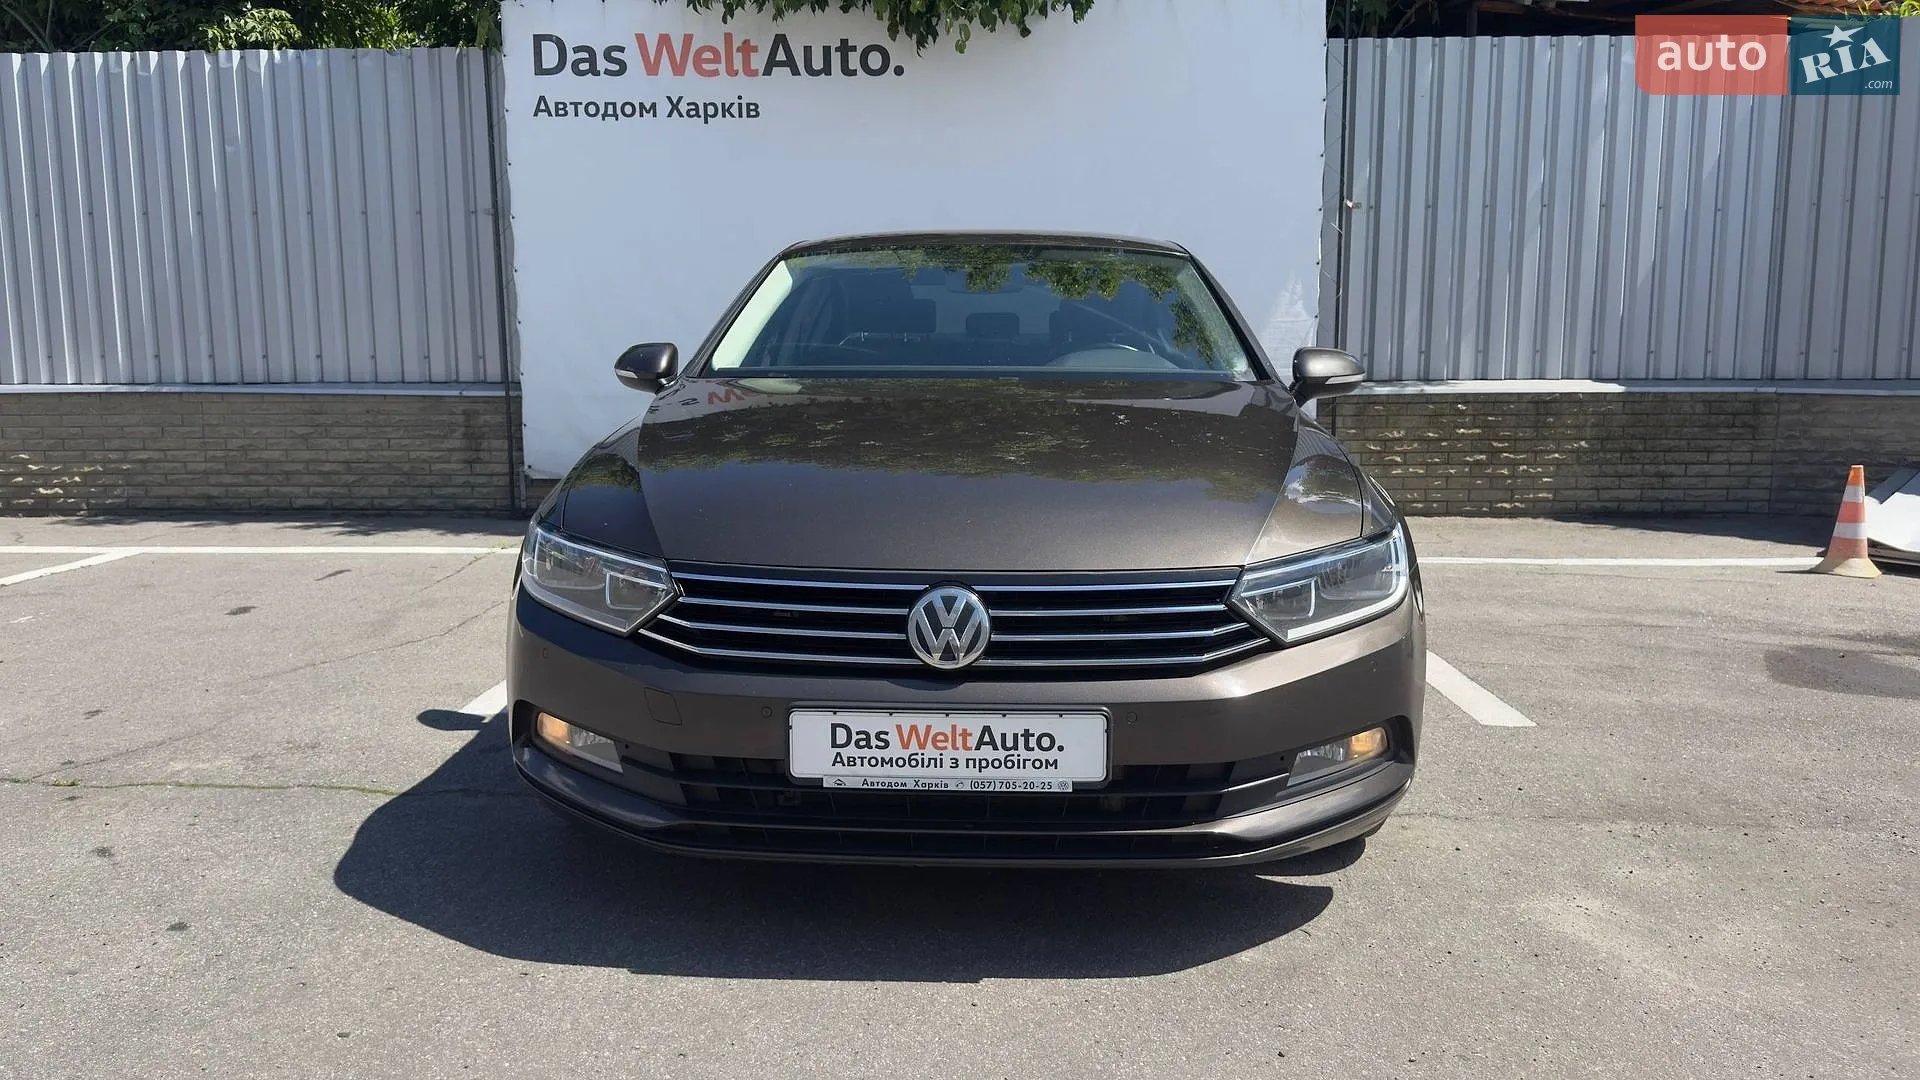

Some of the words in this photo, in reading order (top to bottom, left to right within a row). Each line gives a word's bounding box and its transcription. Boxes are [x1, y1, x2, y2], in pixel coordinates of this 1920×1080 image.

[532, 33, 627, 77] Das
[532, 95, 657, 120] Автодом
[666, 95, 760, 124] Харків
[830, 722, 890, 749] Das
[831, 752, 944, 769] Автомобілі
[949, 755, 959, 769] з
[965, 754, 1059, 773] пробігом
[862, 778, 907, 789] Автодом
[913, 779, 949, 790] Харків
